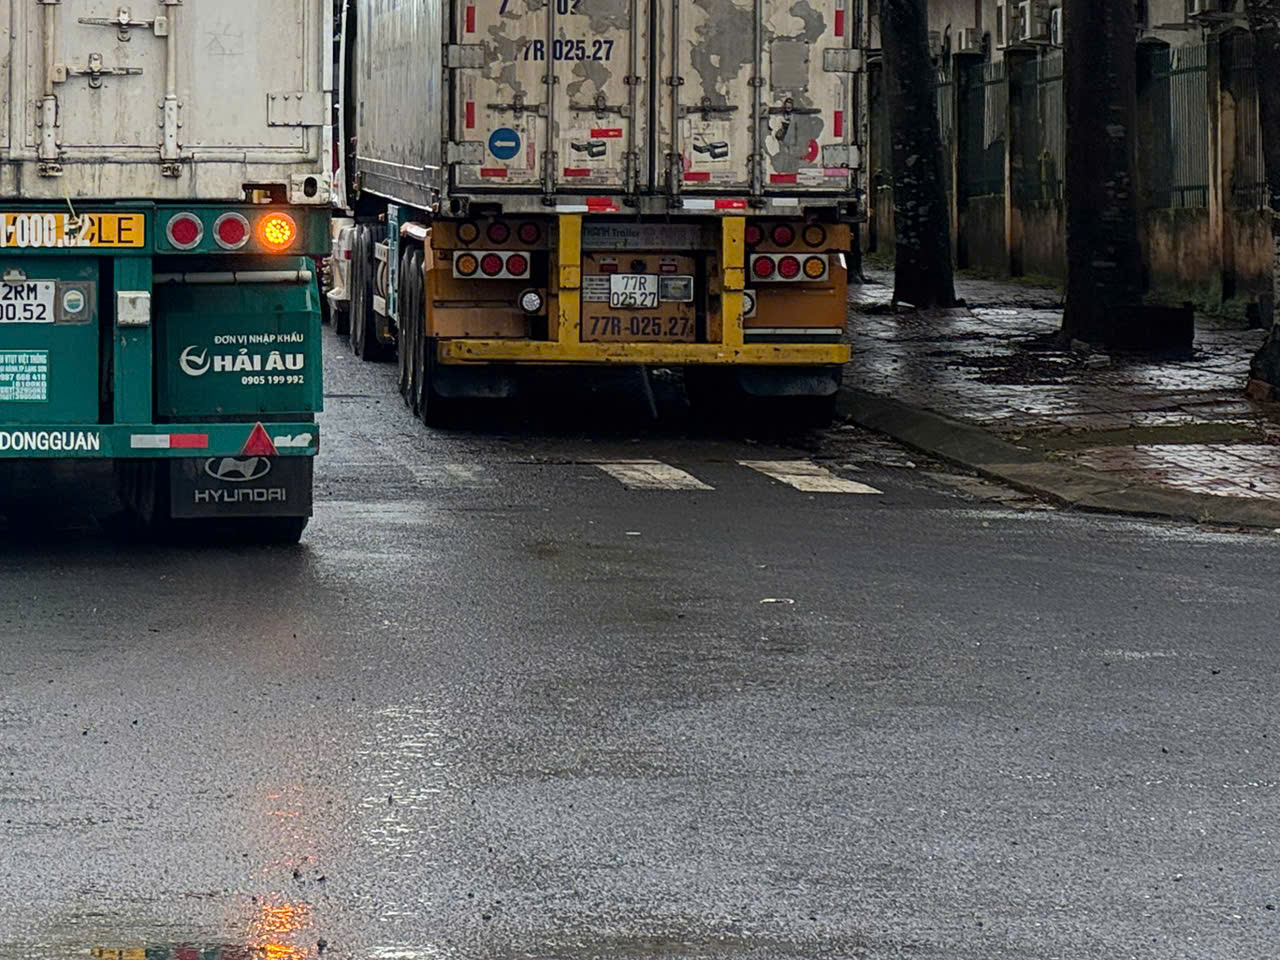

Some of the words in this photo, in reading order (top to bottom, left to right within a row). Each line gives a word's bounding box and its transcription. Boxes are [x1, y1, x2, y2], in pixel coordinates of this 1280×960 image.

[621, 276, 648, 291] 77R
[611, 291, 657, 307] 025.27
[214, 335, 236, 345] ĐƠN
[237, 335, 248, 345] VỊ
[213, 348, 261, 372] HẢI
[265, 350, 304, 371] ÂU
[241, 376, 265, 385] 0905
[268, 375, 285, 385] 199
[286, 375, 305, 385] 992
[194, 487, 287, 502] HYUNDAI
